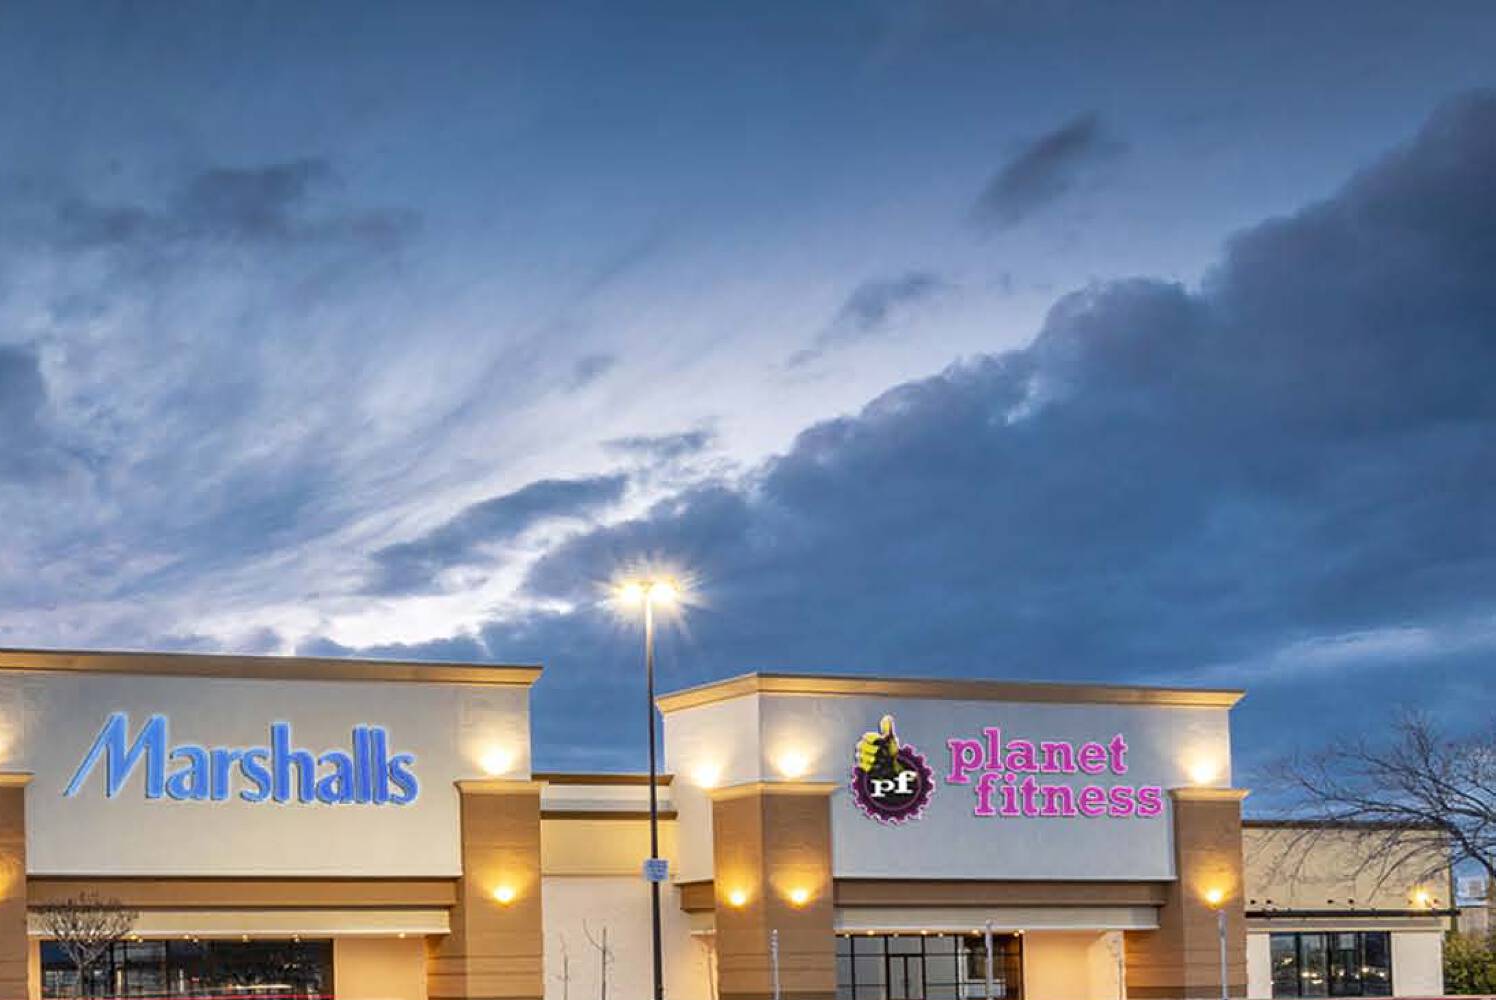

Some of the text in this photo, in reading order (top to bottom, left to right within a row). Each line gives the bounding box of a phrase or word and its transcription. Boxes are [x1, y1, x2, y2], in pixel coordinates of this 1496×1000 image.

[63, 711, 418, 804] Marshalls
[946, 727, 1128, 783] planet
[871, 770, 917, 798] pf
[974, 773, 1163, 817] fitness
